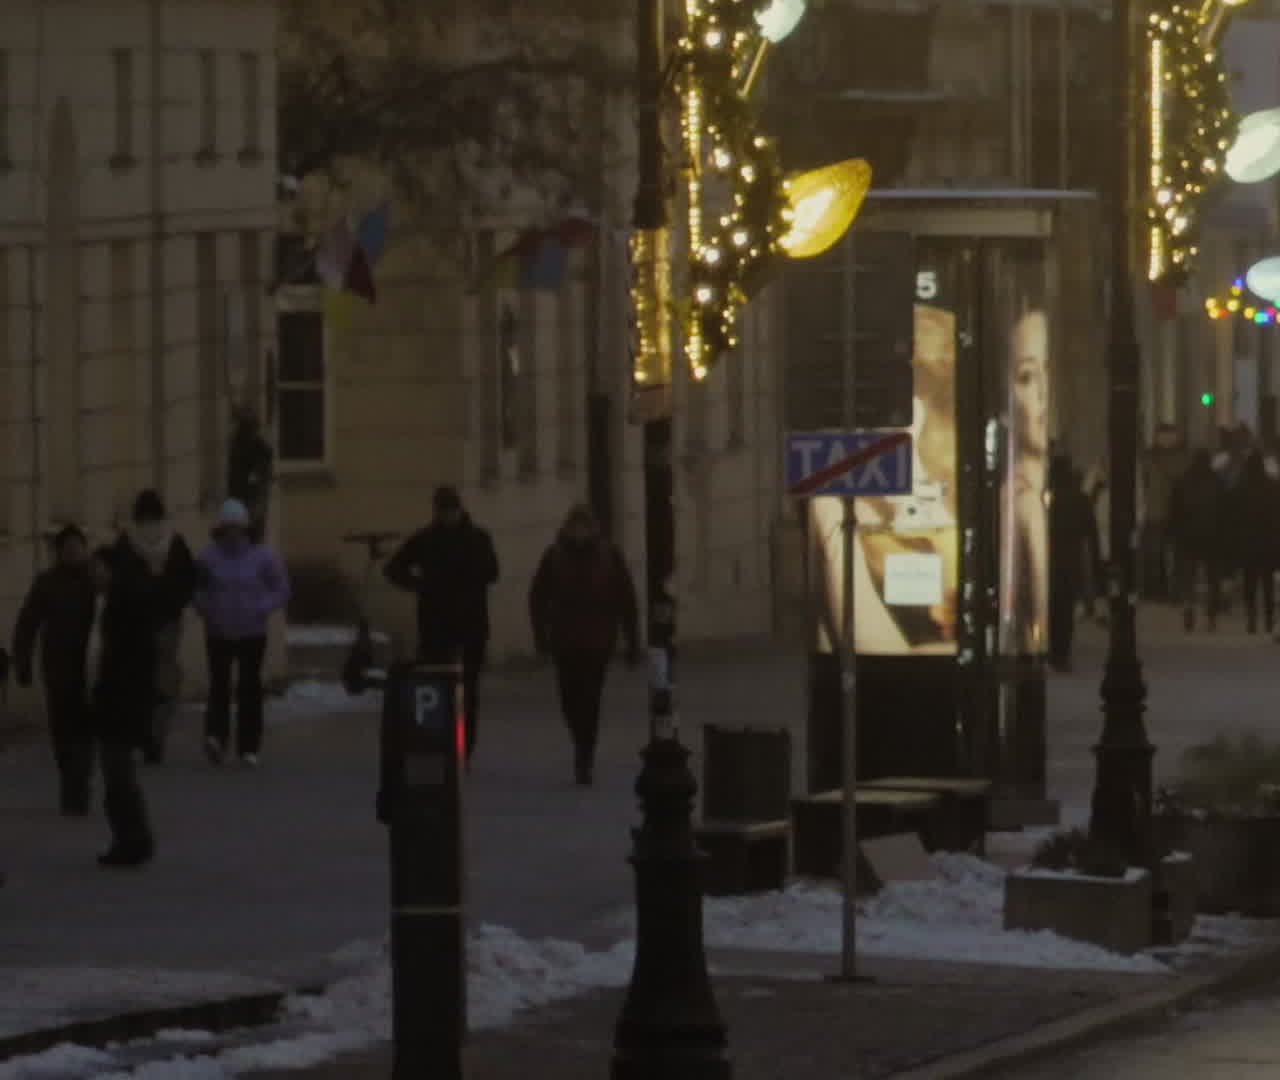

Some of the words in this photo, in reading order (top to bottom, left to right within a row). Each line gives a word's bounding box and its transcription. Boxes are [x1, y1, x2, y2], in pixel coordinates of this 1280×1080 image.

[915, 271, 938, 300] 5
[791, 440, 908, 490] TAXI
[415, 684, 439, 725] P
